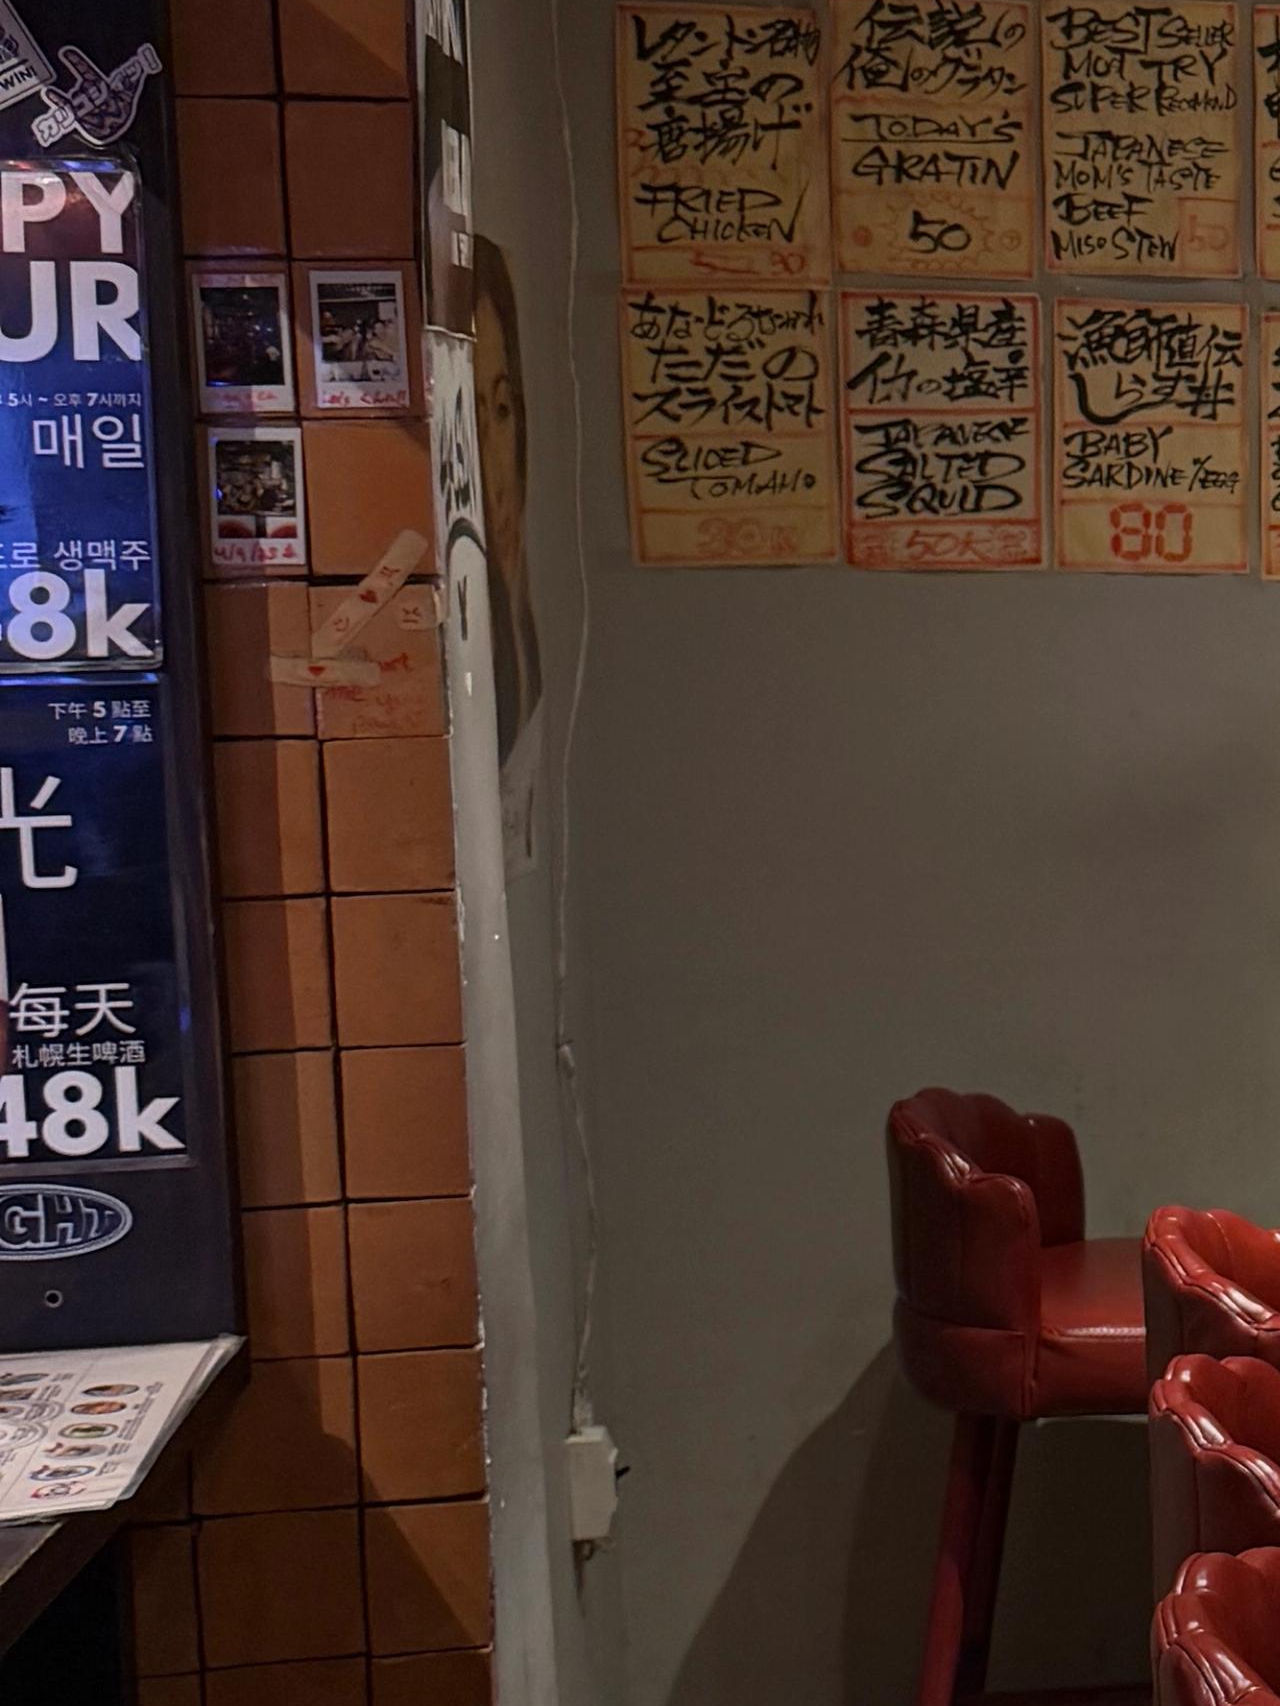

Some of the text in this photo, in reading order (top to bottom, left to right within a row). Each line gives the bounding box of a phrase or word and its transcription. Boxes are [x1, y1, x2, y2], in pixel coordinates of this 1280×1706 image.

[1047, 7, 1172, 51] BEST
[1140, 50, 1228, 83] TRY
[1051, 82, 1150, 113] SUPER
[850, 111, 1023, 143] TODAY'S
[853, 147, 1020, 190] GRATIN
[1054, 160, 1134, 190] MOM'S
[635, 183, 782, 217] FRIED
[1053, 192, 1153, 225] BEEF
[909, 211, 972, 253] 50
[1112, 226, 1179, 262] STEW
[87, 393, 142, 408] 7시까지
[32, 417, 145, 469] 매일
[643, 437, 783, 477] SLICED
[1064, 426, 1174, 460] BABY
[857, 450, 1026, 484] SALTED
[1063, 453, 1188, 489] SARDINE
[857, 482, 1023, 519] SQUID
[1110, 501, 1194, 562] 80
[54, 541, 152, 571] 생맥주
[48, 700, 152, 721] 下午 5 點至
[68, 726, 108, 746] 晚上
[8, 981, 138, 1038] 每天
[13, 1039, 147, 1068] 札幌生啤酒
[0, 1065, 187, 1157] 48k
